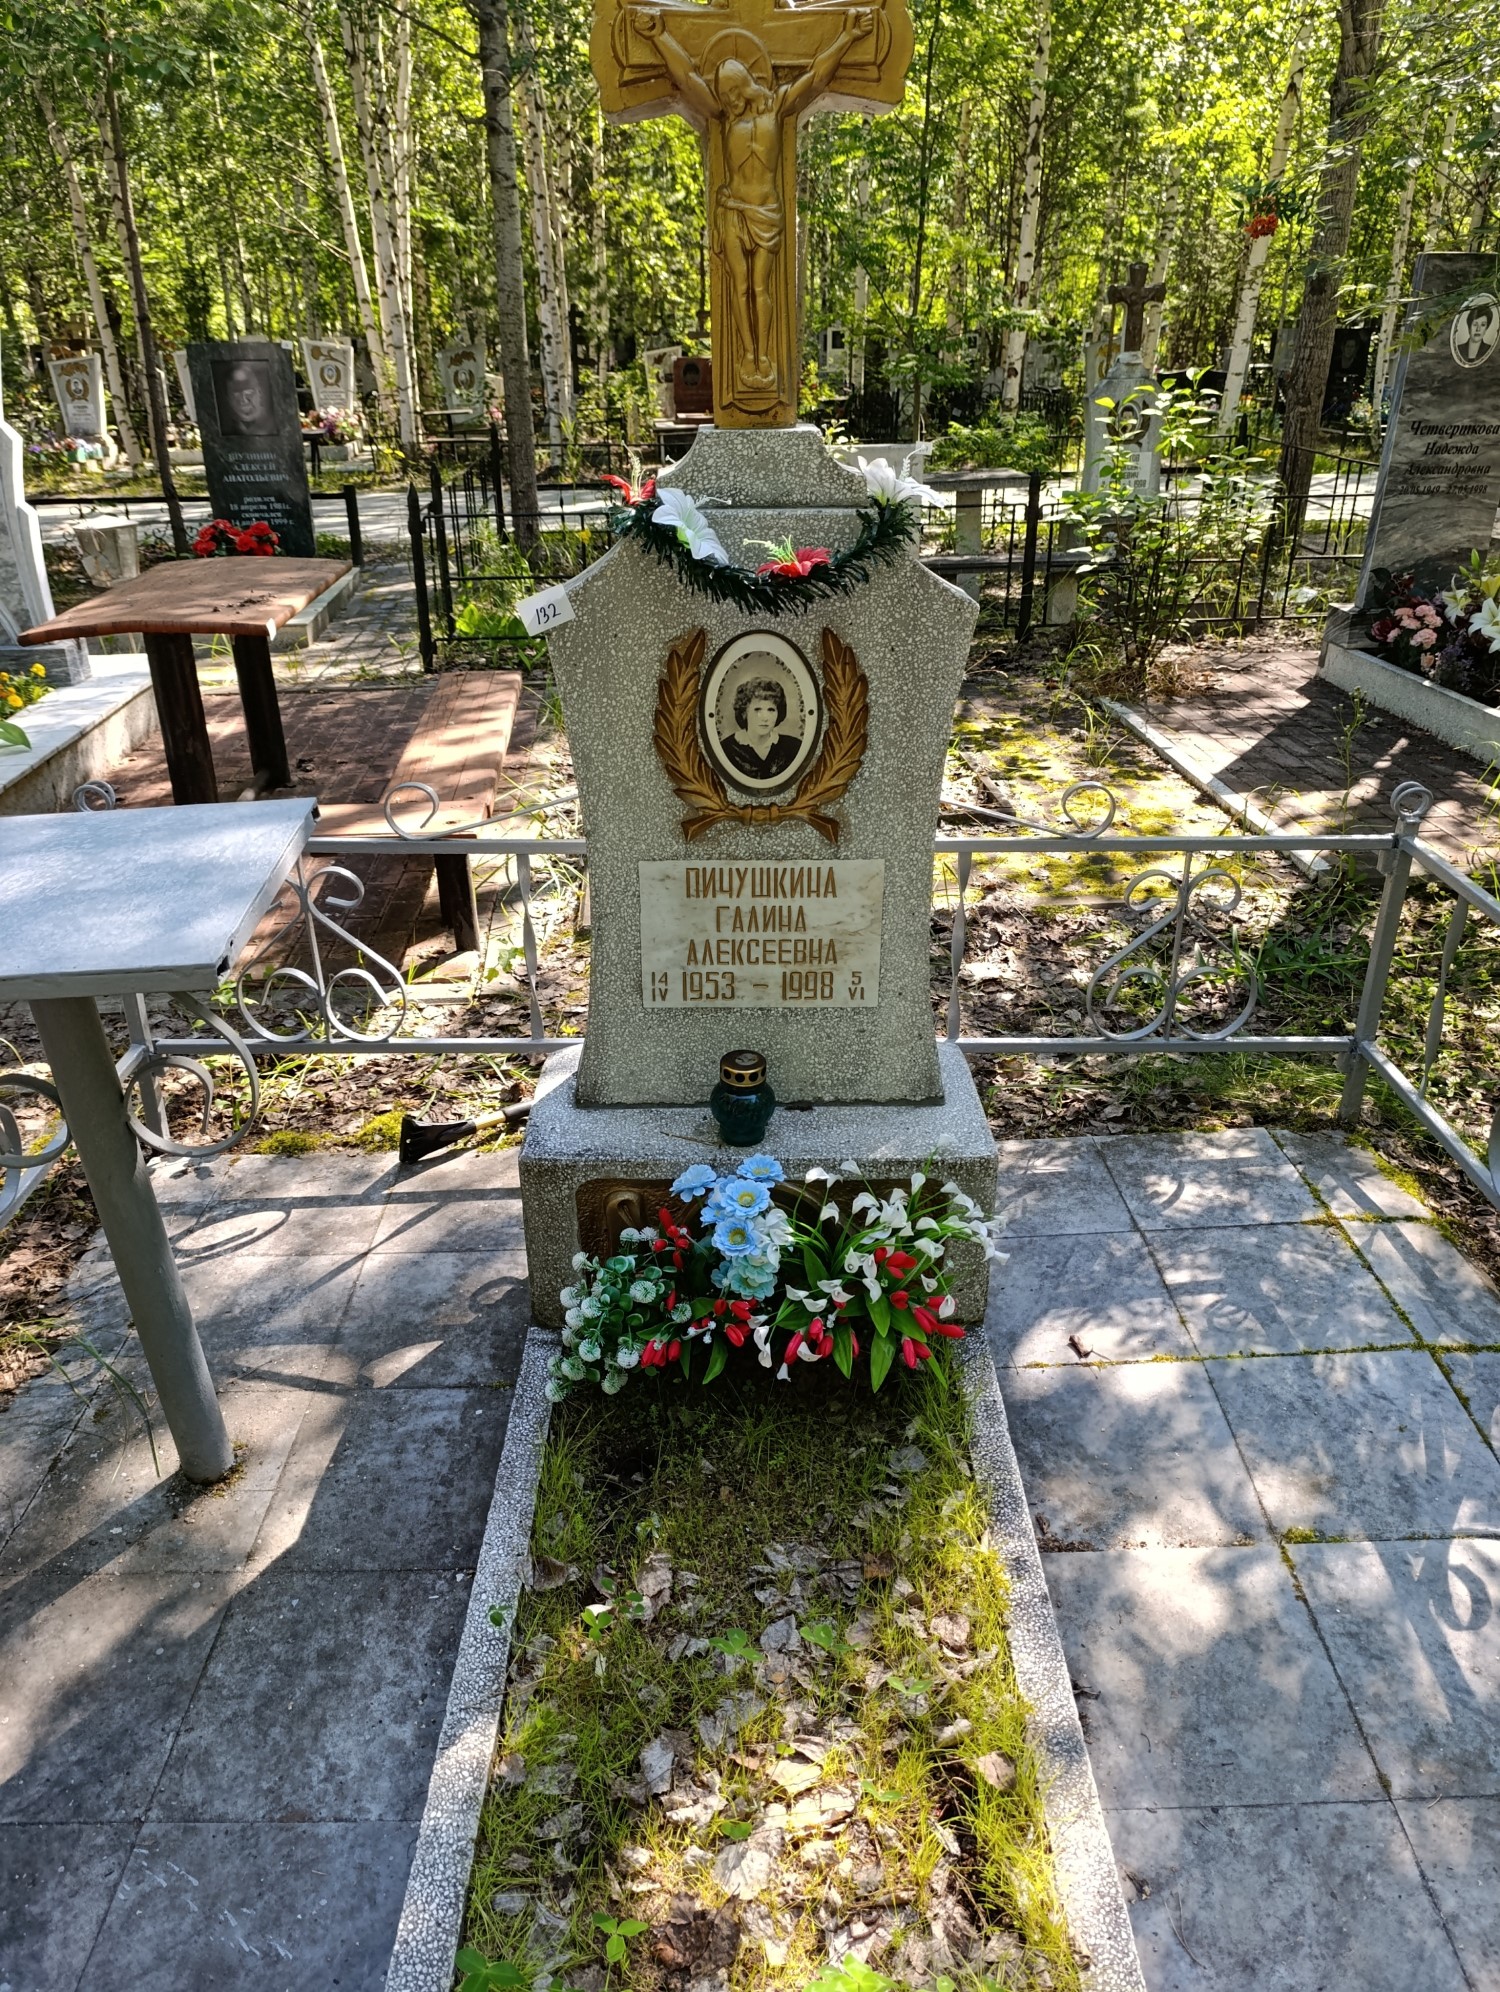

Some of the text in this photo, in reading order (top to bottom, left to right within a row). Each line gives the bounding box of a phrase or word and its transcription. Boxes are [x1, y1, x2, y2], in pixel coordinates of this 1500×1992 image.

[1424, 441, 1480, 455] Надежда
[1403, 461, 1492, 478] Александровна
[535, 602, 562, 625] 132
[685, 866, 838, 899] ПИЧУШКИНА
[716, 905, 807, 933] ГАЛИНА
[686, 938, 838, 966] АЛЕКСЕЕВНА
[651, 971, 669, 987] 14
[682, 971, 736, 1001] 1953
[781, 971, 834, 1001] 1998
[851, 970, 863, 986] 5
[848, 987, 865, 1001] VI
